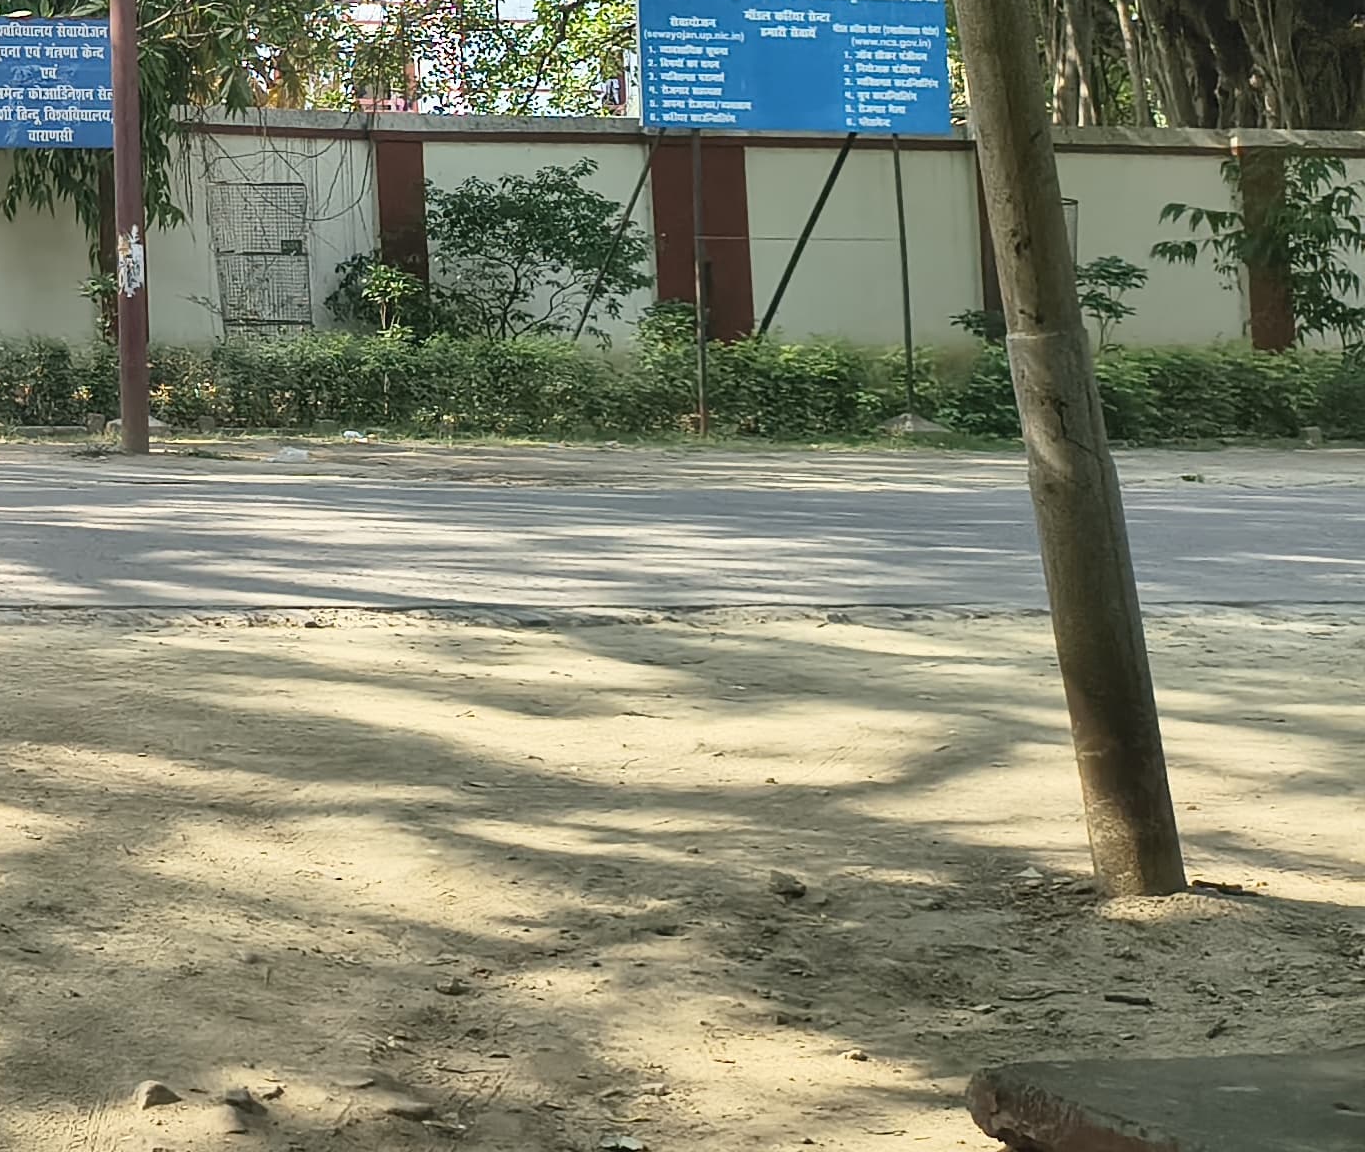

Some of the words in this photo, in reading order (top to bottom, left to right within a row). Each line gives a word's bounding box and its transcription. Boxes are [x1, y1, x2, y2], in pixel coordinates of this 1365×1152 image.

[56, 22, 108, 38] सेवायोजन
[24, 43, 42, 58] एवं
[40, 64, 58, 79] एवं
[16, 106, 42, 125] हिन्दू
[27, 127, 74, 143] वाराणसी
